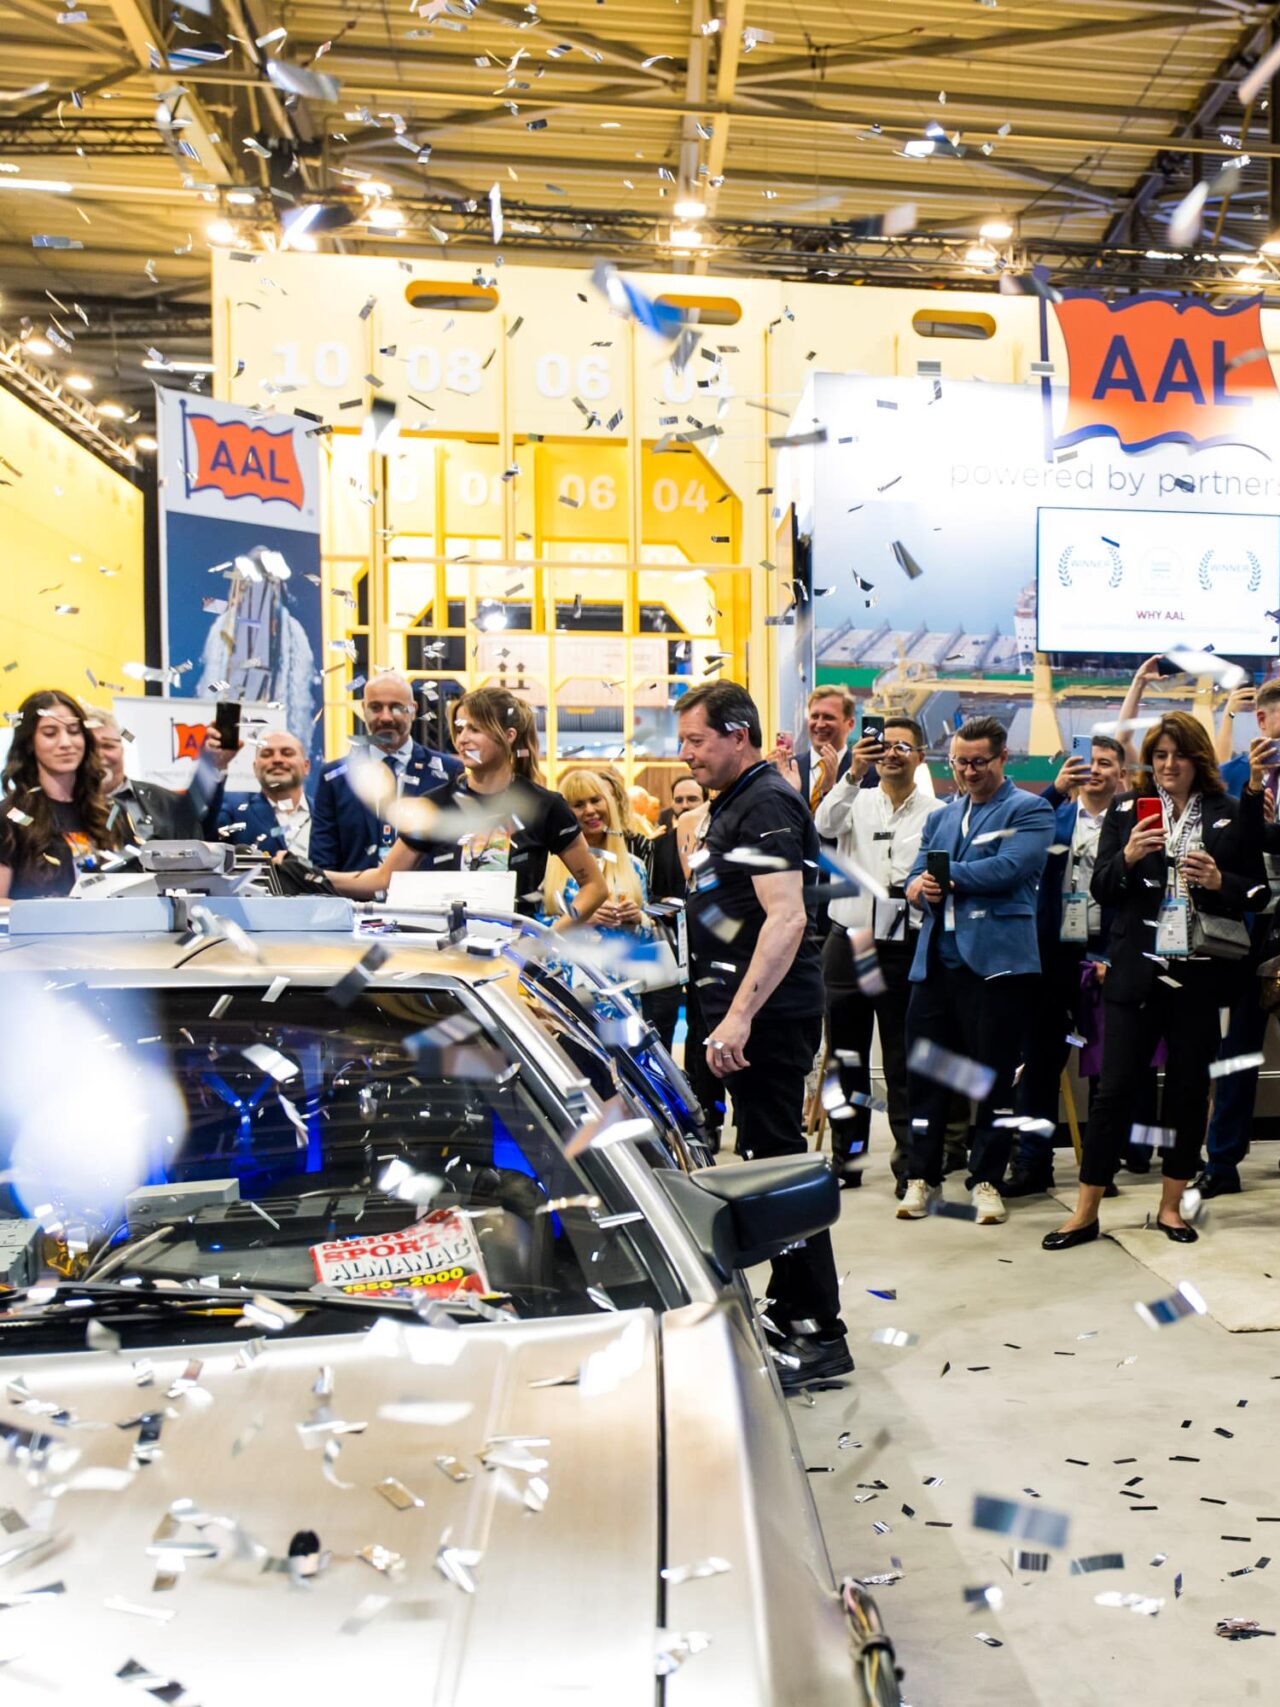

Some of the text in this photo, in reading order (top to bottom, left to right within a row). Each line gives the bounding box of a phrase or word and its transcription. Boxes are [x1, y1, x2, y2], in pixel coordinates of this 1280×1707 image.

[272, 342, 347, 388] 10
[406, 346, 481, 393] 08
[535, 354, 610, 399] 06
[1092, 335, 1252, 406] AAL
[209, 440, 290, 484] AAL
[951, 464, 1094, 489] powered
[1108, 464, 1146, 496] by
[559, 474, 616, 511] 06
[653, 479, 709, 513] 04
[1136, 610, 1185, 620] WHY AAL
[332, 1237, 471, 1281] ALMANAC
